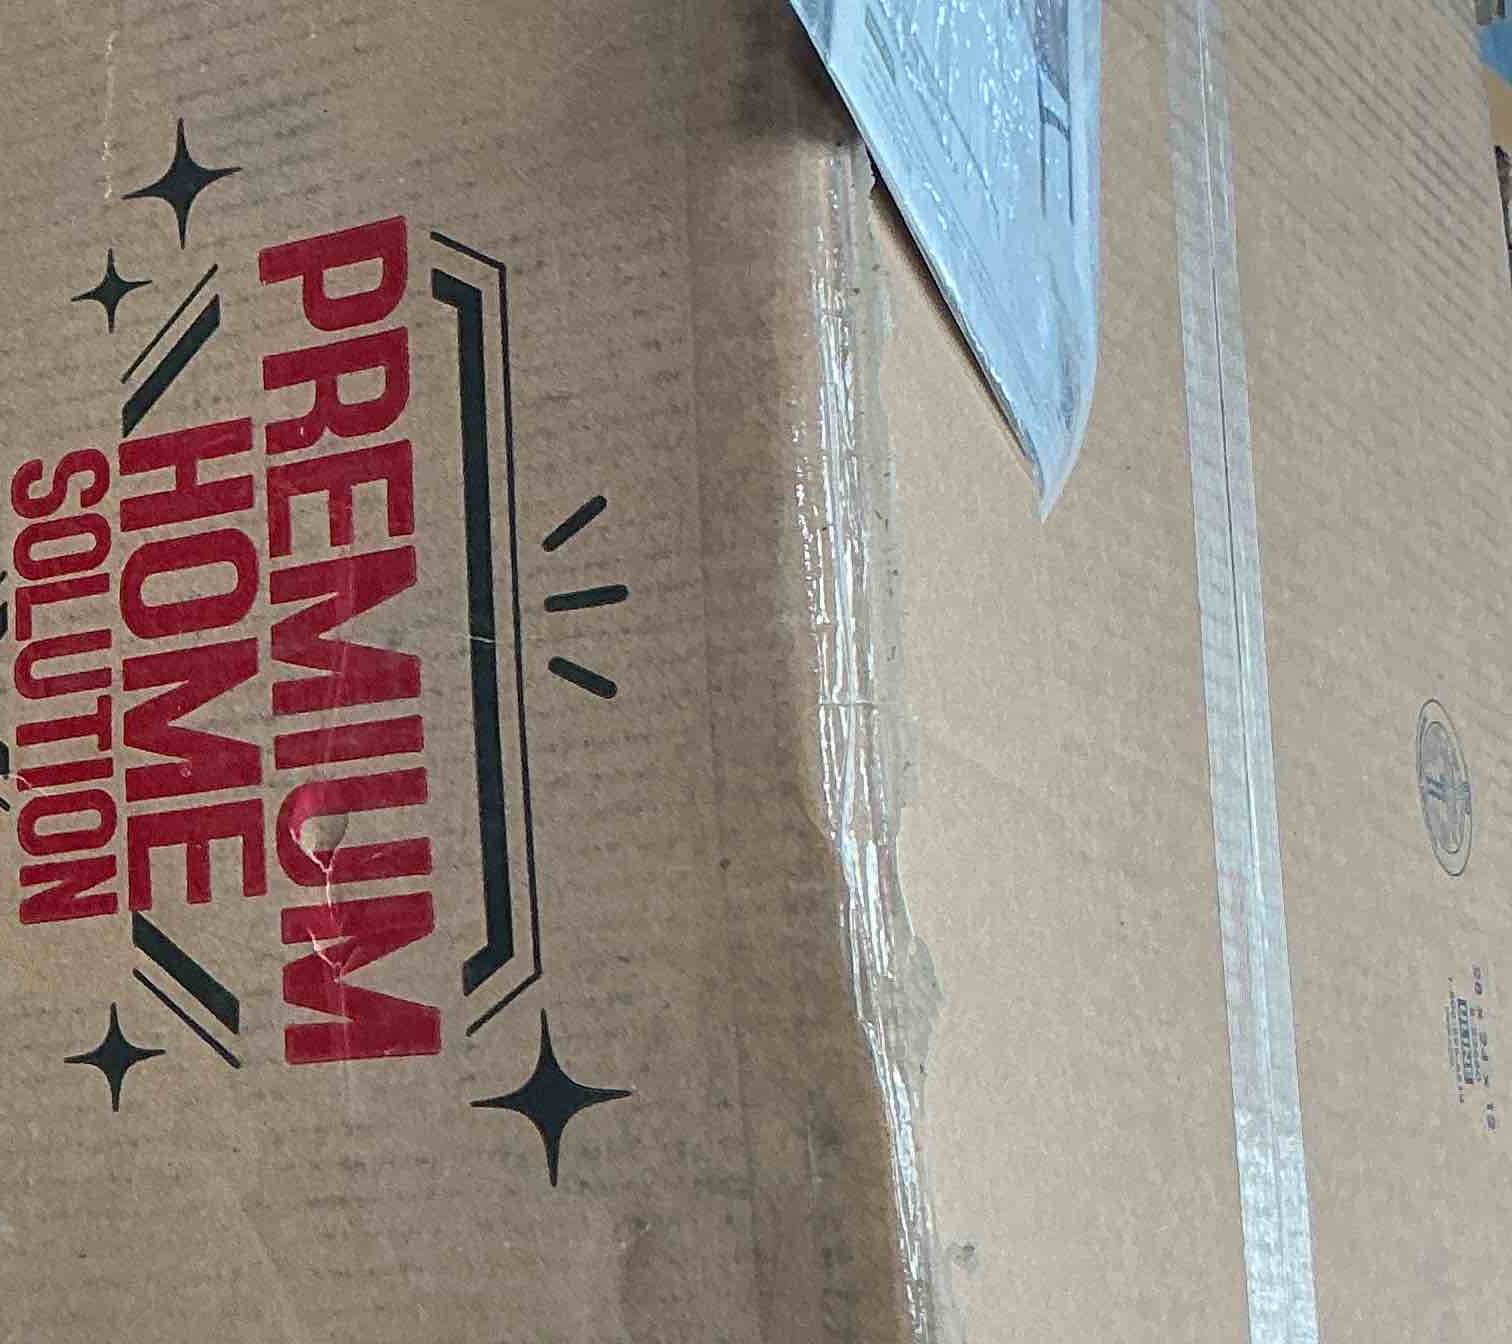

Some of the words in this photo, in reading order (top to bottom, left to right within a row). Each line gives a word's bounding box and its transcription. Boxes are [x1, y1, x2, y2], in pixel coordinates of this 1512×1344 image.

[10, 447, 119, 926] SOLUTION
[117, 416, 268, 913] HOME
[256, 212, 441, 1067] PREMIUM
